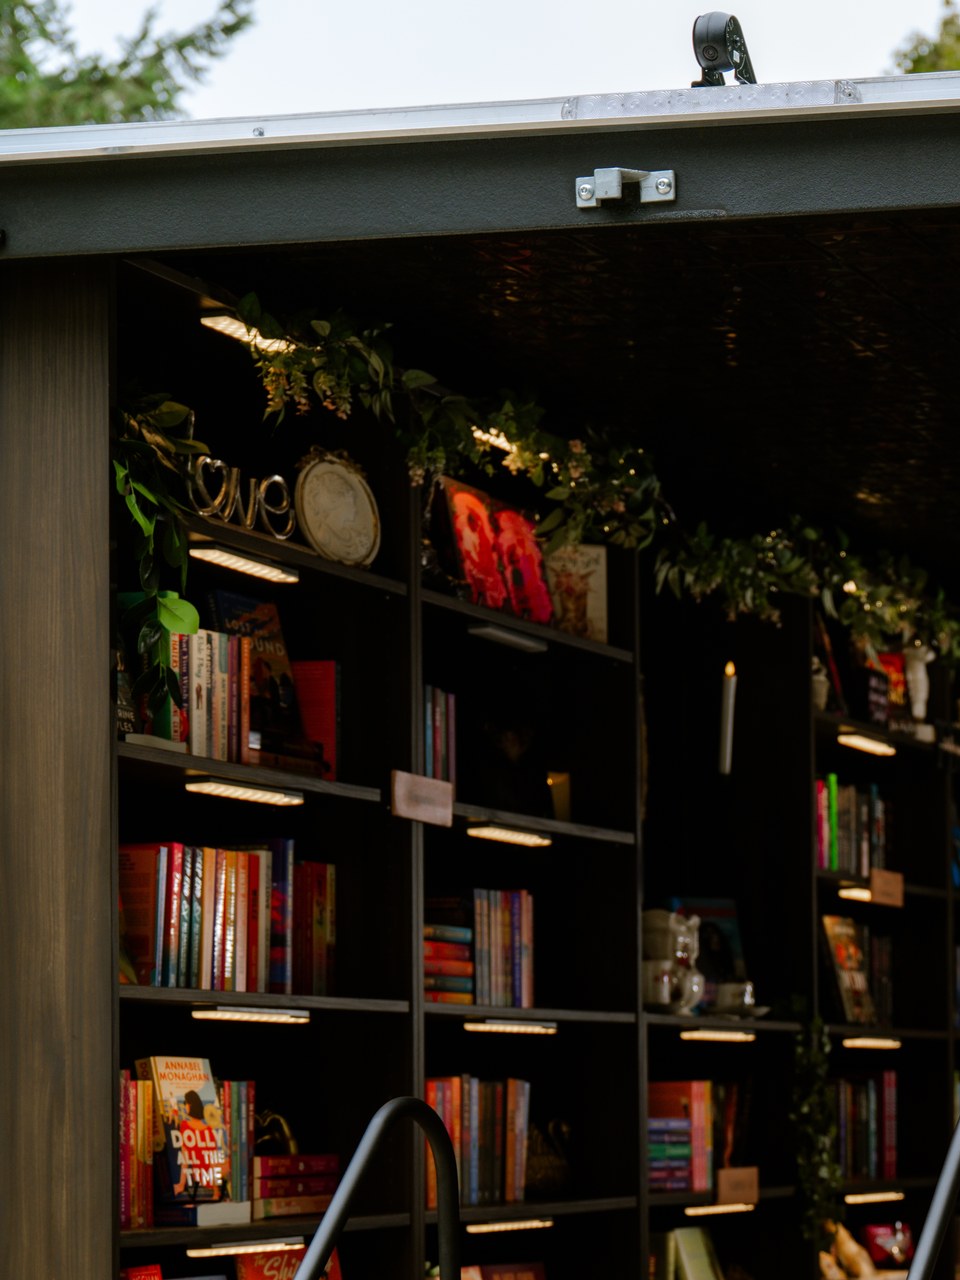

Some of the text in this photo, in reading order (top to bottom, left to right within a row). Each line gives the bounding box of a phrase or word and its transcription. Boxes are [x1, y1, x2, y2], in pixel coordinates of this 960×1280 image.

[165, 1061, 202, 1072] ANNABEL
[159, 1072, 210, 1082] MONAGHAN
[170, 1129, 223, 1149] DOLLY
[177, 1150, 226, 1165] ALL THE
[185, 1167, 223, 1187] TIME
